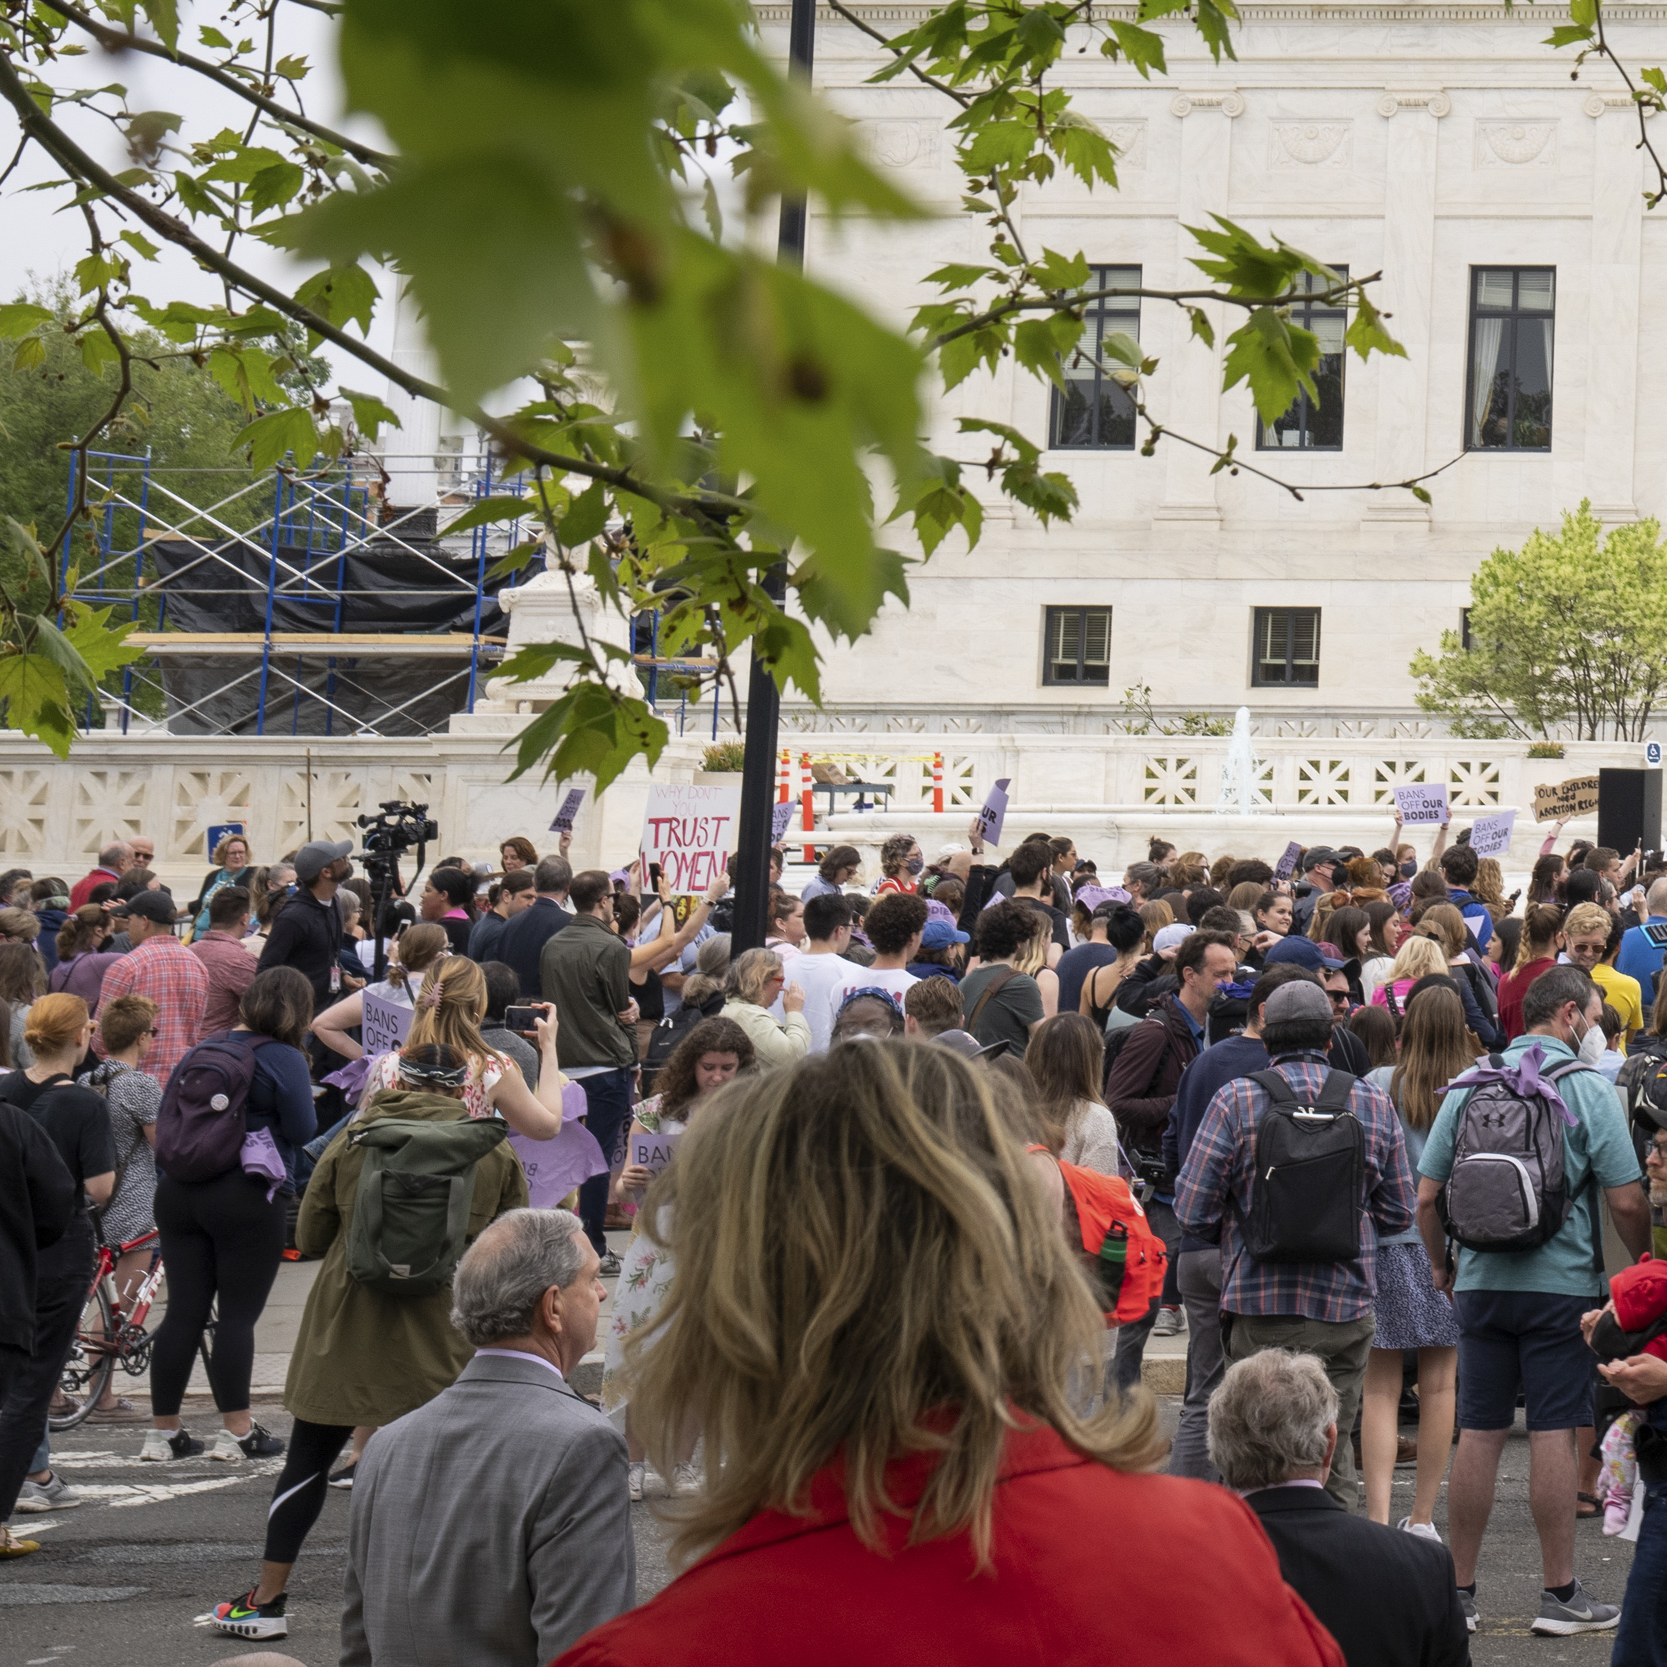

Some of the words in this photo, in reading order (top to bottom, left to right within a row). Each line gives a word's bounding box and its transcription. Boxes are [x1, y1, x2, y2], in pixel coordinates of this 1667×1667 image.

[654, 785, 684, 799] WHY
[1398, 789, 1426, 801] BANS
[1538, 787, 1558, 798] OUR
[1562, 780, 1599, 795] CHILDRE
[672, 800, 697, 816] YOU
[772, 807, 789, 819] ANS
[1401, 800, 1422, 811] OFF
[1422, 799, 1443, 809] OUR
[1578, 799, 1599, 811] RIGH
[981, 805, 998, 824] UR
[1404, 810, 1439, 821] BODIES
[648, 816, 731, 849] TRUST
[1474, 820, 1499, 834] BANS
[1472, 832, 1491, 846] OFF
[1491, 827, 1509, 841] OUR
[641, 850, 728, 892] WOMEN
[931, 906, 950, 916] DIE
[366, 1002, 398, 1034] BANS
[366, 1026, 389, 1050] OFF
[255, 1133, 275, 1150] UR
[638, 1145, 676, 1164] BAN
